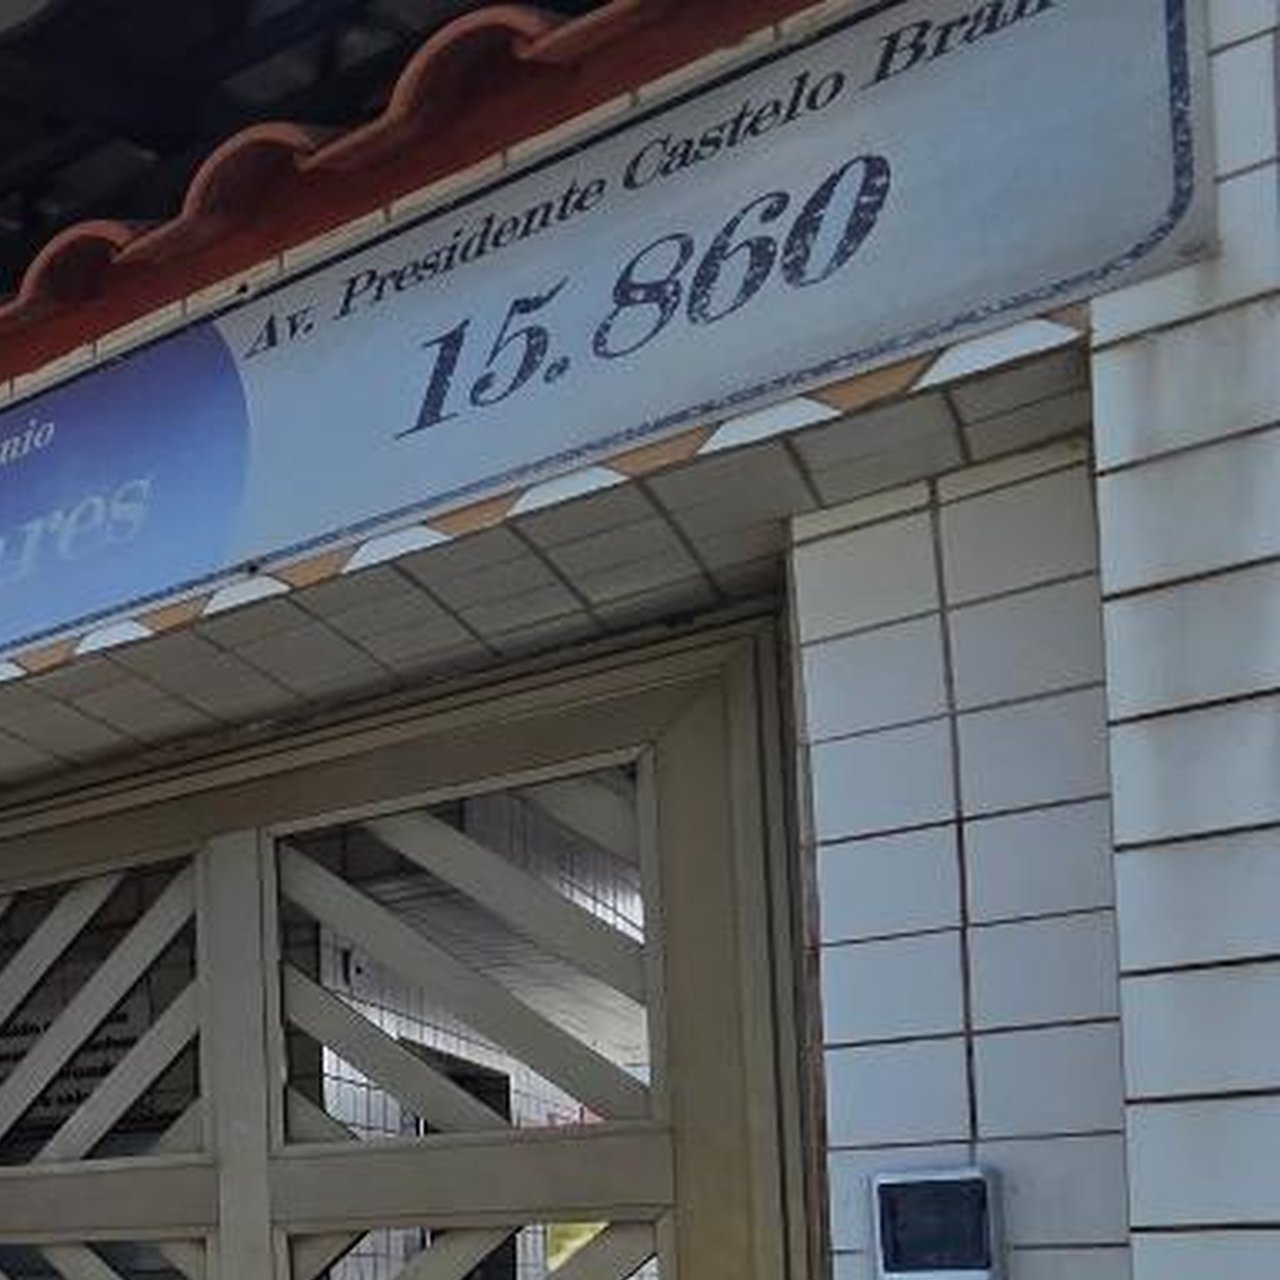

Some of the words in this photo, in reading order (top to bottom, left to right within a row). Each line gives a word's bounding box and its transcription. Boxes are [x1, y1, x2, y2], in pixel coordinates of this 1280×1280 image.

[243, 309, 315, 360] Av.
[332, 175, 606, 320] Presidente
[623, 69, 846, 190] Castelo
[395, 153, 893, 440] 15.860
